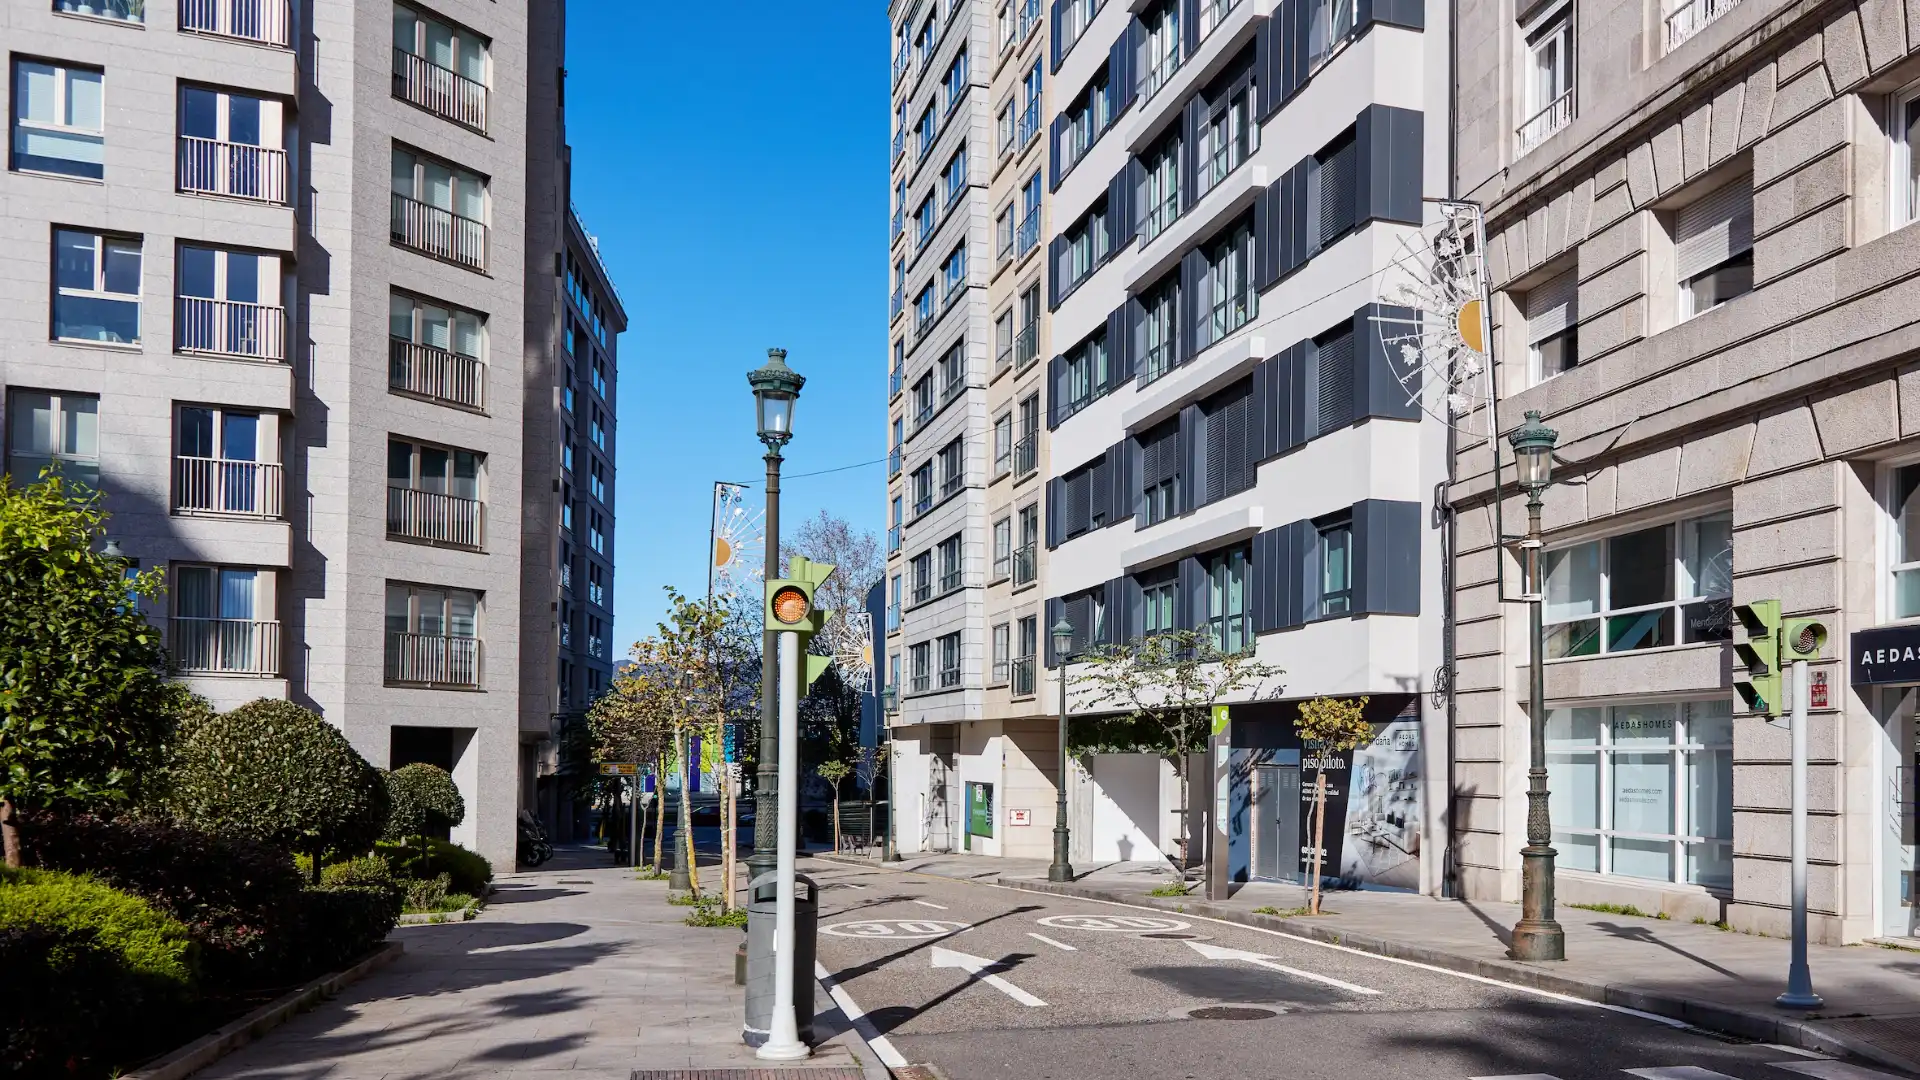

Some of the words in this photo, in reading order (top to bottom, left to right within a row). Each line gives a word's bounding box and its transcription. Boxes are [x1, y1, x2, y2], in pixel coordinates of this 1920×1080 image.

[1861, 646, 1920, 665] AEDA
[1302, 755, 1320, 772] piso
[1320, 755, 1346, 772] piloto.
[846, 922, 949, 935] 30
[1060, 916, 1169, 929] 30
